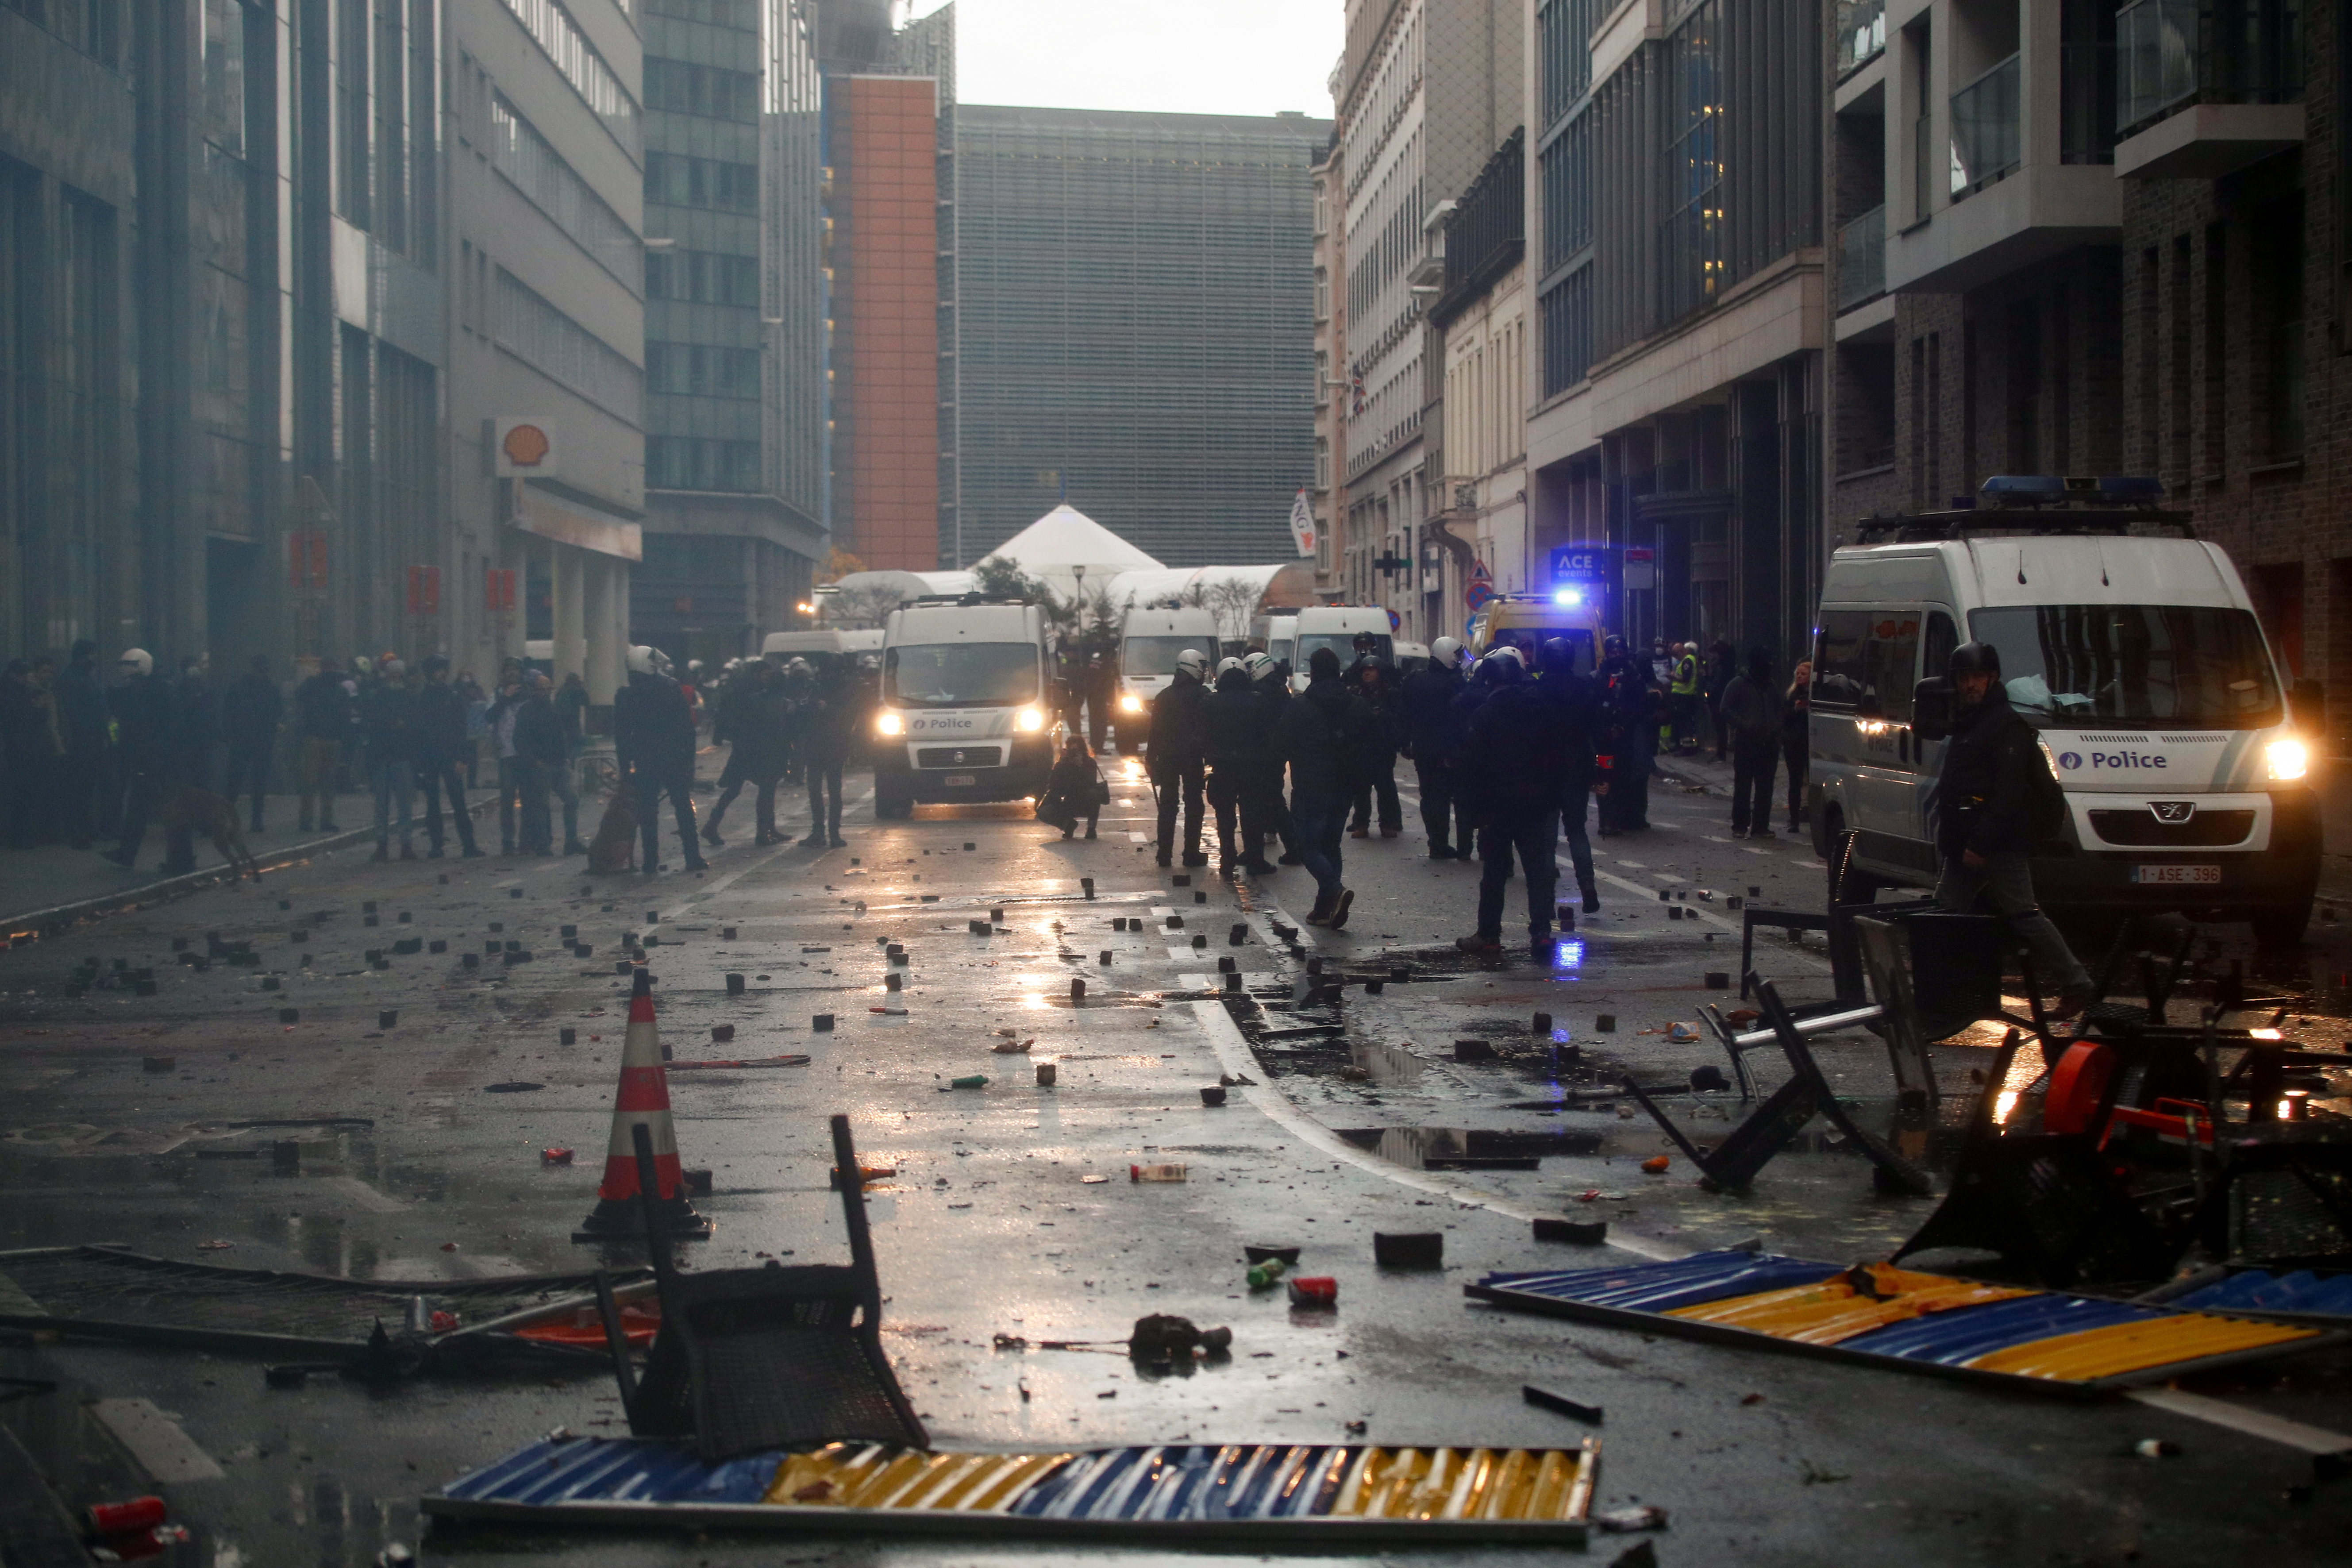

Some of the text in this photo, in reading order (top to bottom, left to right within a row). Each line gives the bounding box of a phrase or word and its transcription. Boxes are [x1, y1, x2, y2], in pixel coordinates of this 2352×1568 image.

[1559, 555, 1593, 569] ACE
[931, 719, 971, 728] Police
[2092, 751, 2167, 768] Police
